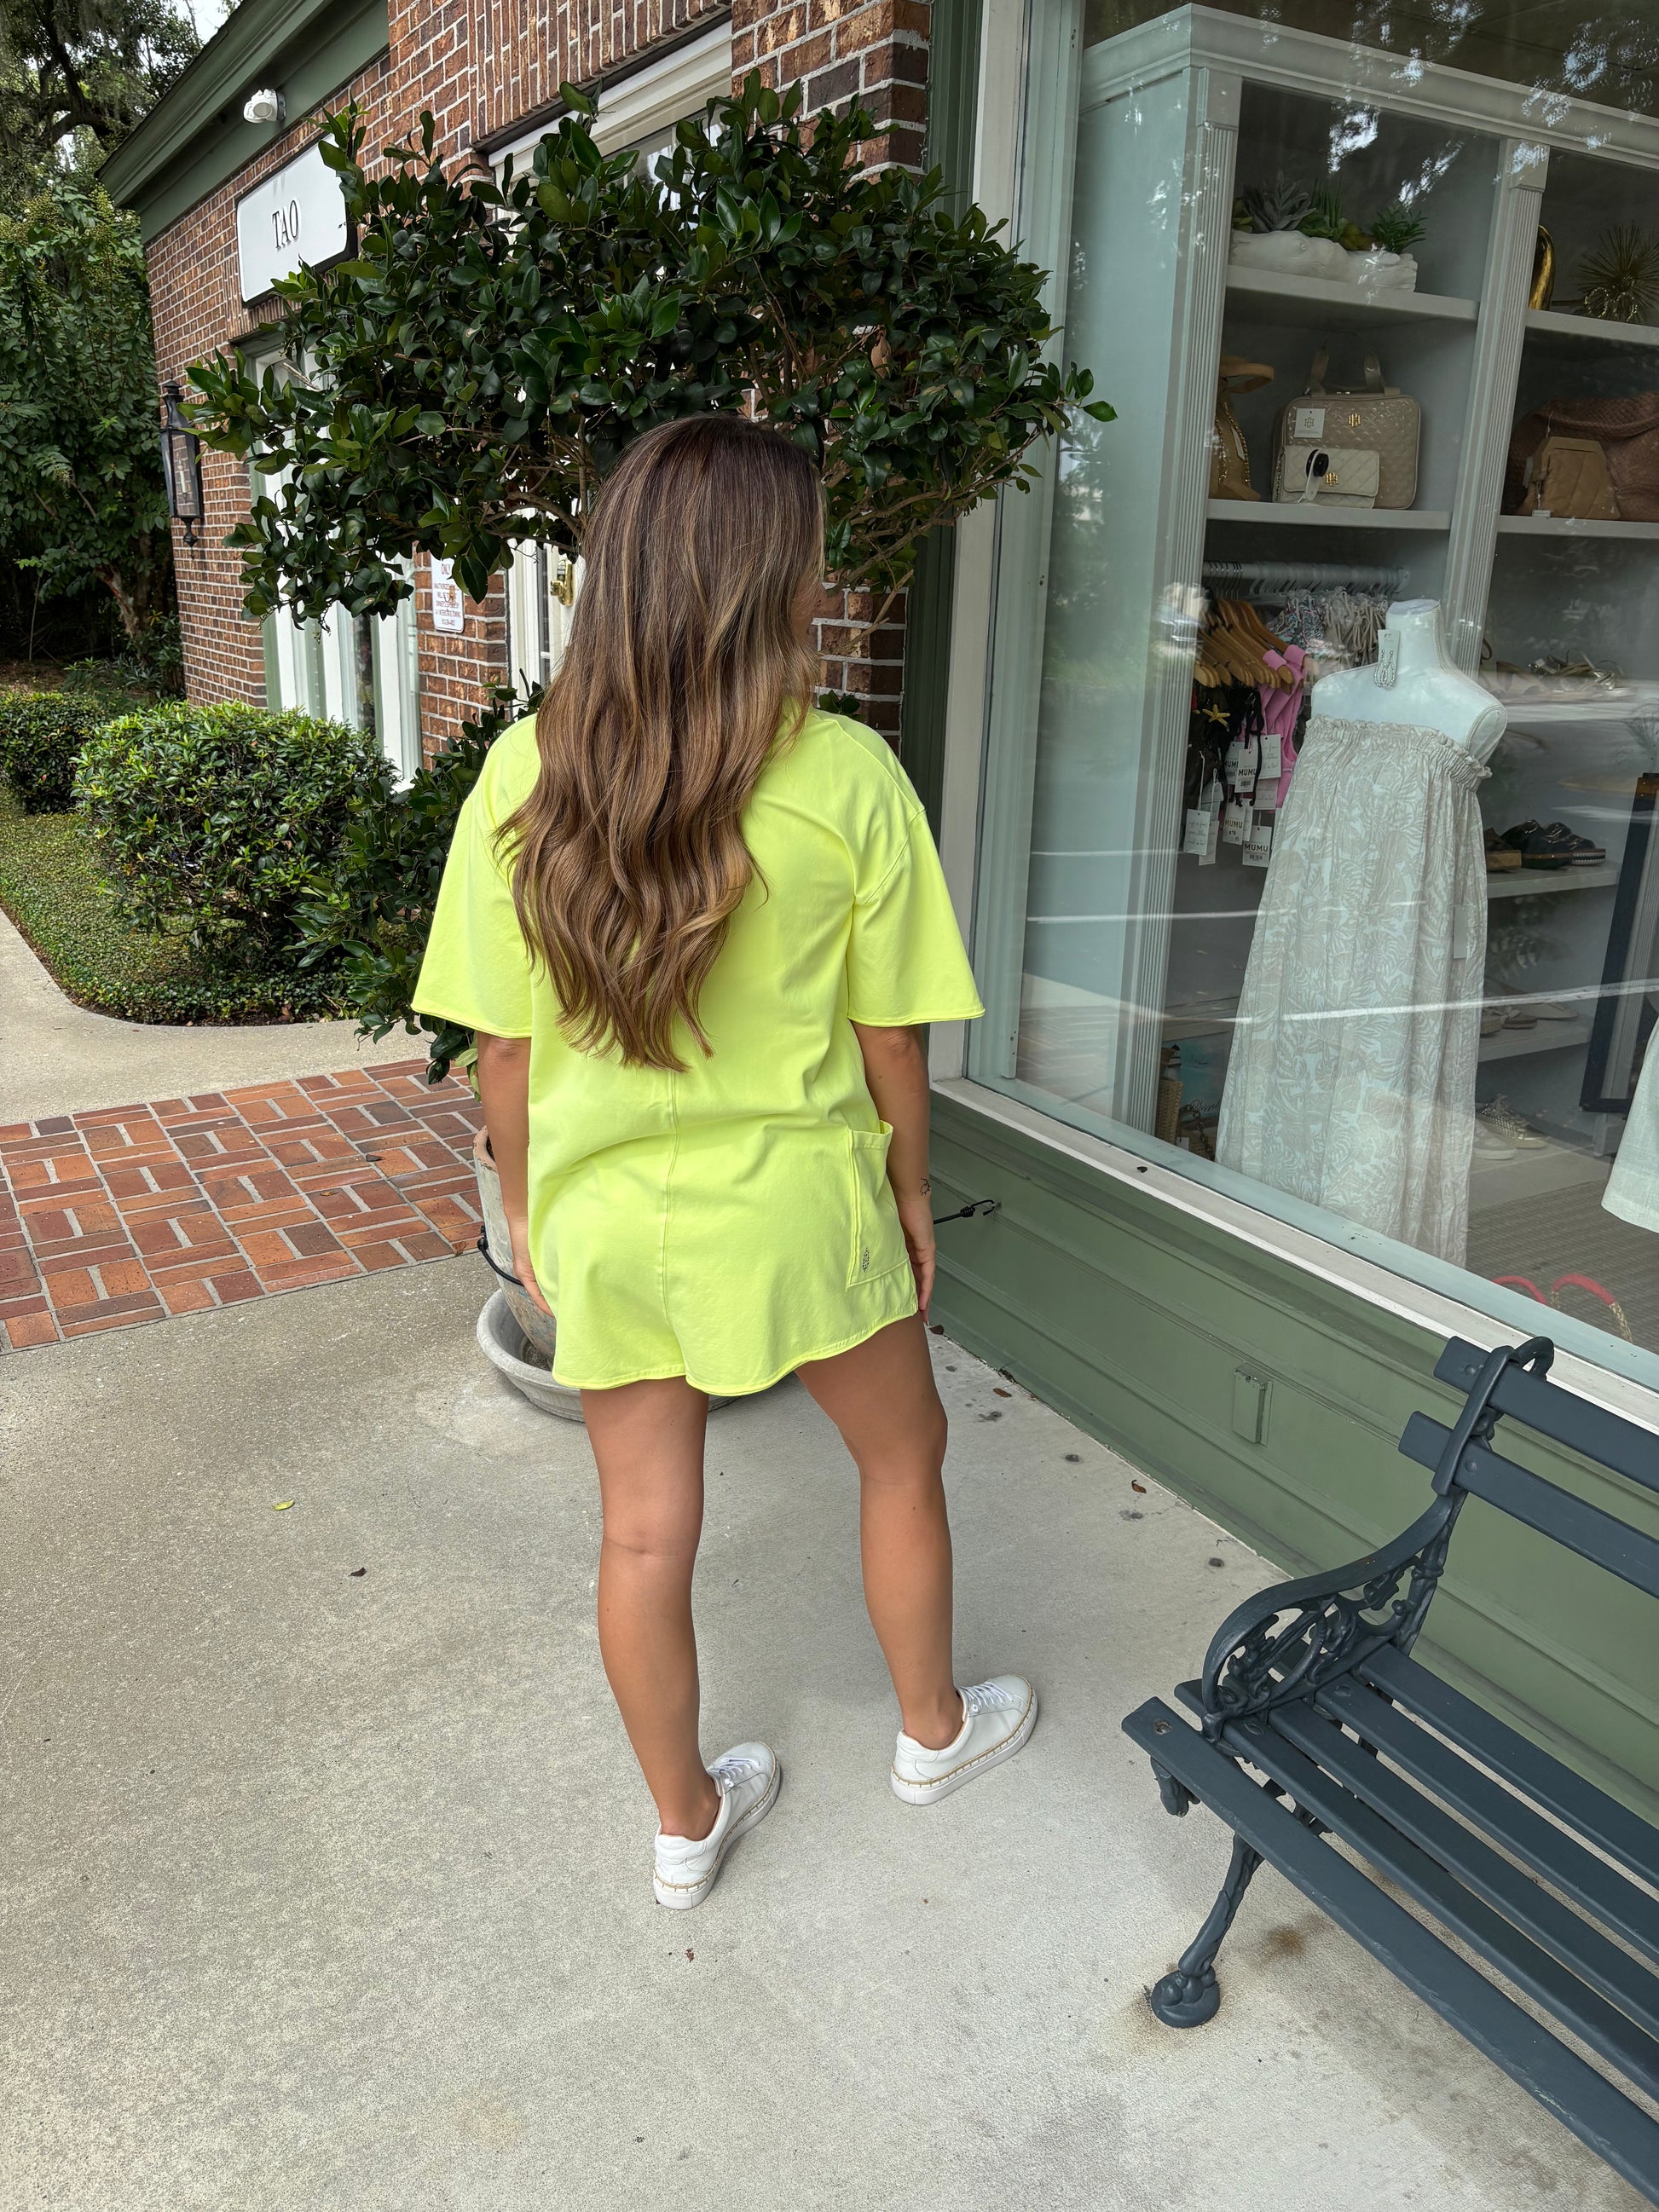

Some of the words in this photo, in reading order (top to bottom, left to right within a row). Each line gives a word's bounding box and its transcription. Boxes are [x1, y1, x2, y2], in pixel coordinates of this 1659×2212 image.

[272, 199, 299, 249] TAO
[1225, 819, 1243, 829] MUMU
[1245, 843, 1269, 852] MUMU
